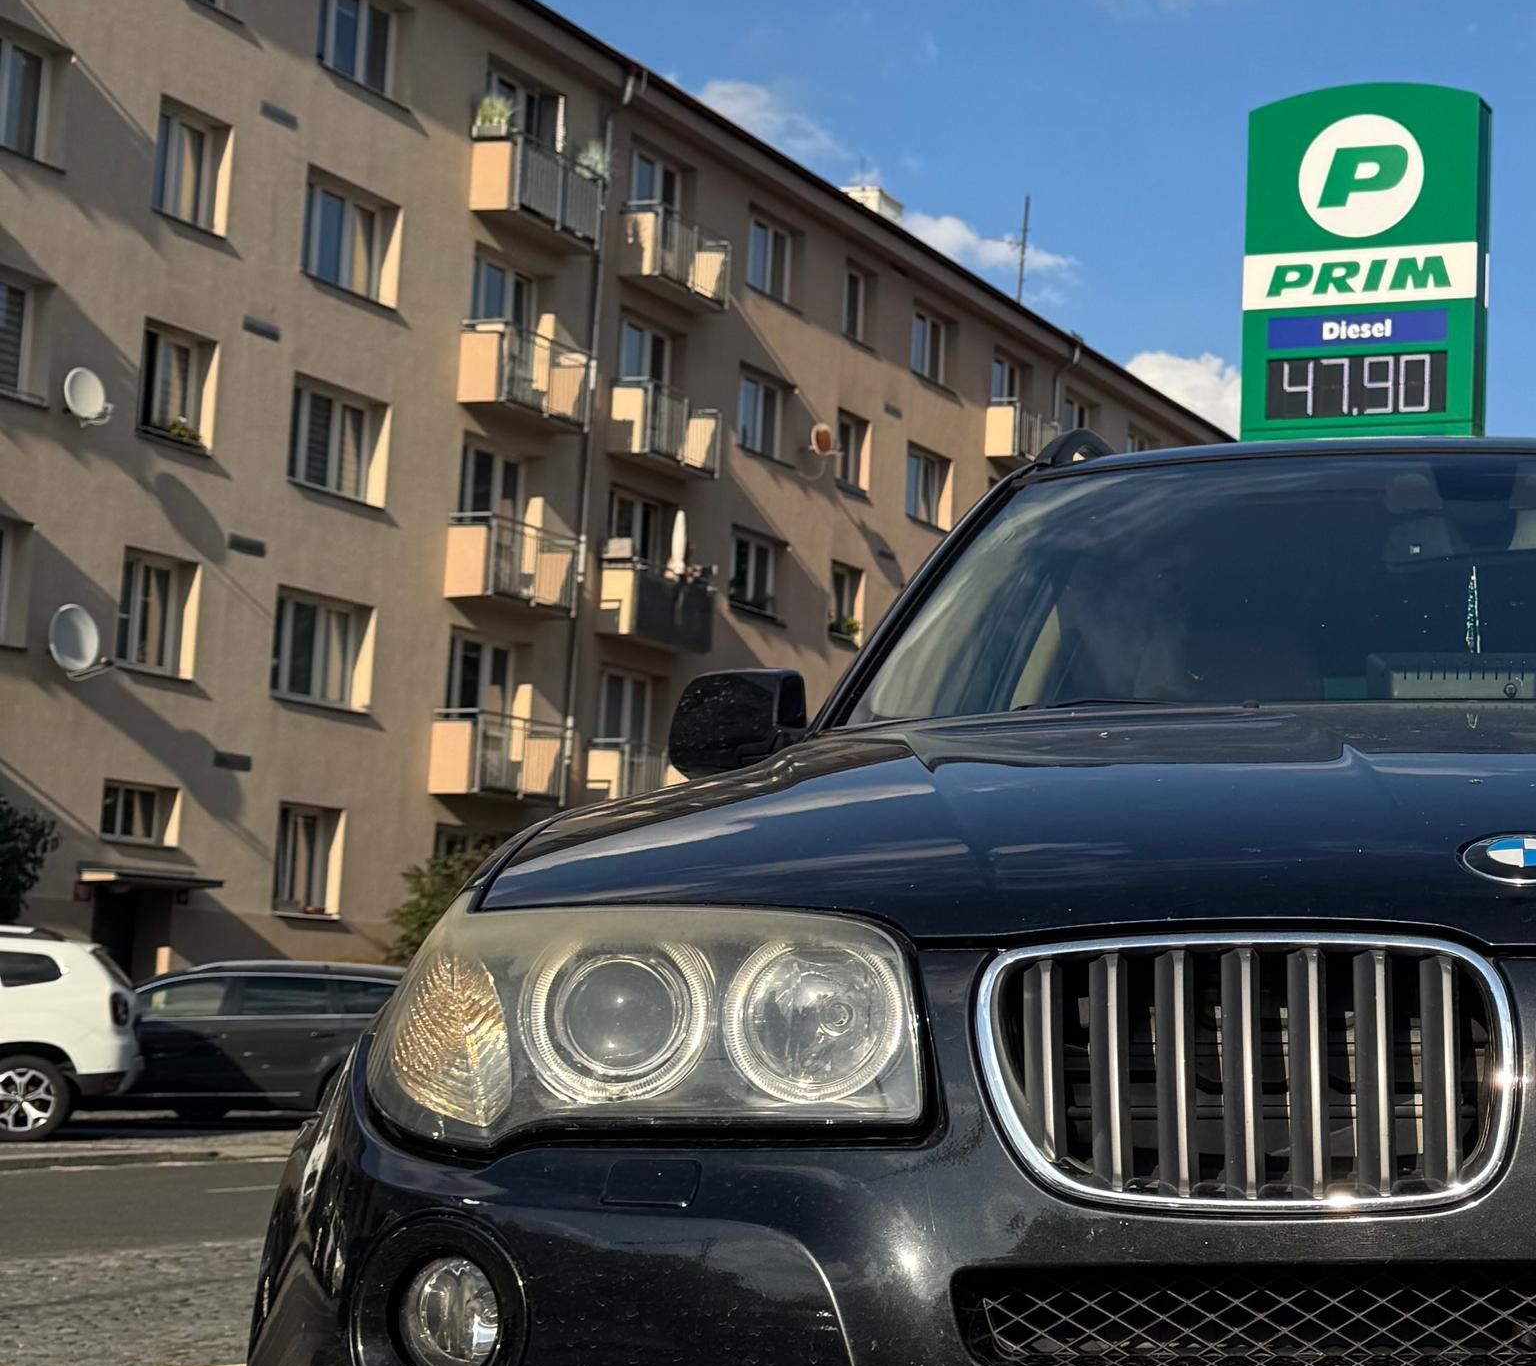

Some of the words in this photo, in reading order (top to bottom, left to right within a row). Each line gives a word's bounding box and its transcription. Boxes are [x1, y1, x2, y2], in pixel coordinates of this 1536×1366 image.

[1317, 144, 1409, 209] P
[1266, 255, 1452, 298] PRIM
[1321, 318, 1393, 341] Diesel
[1282, 353, 1431, 416] 47.90
